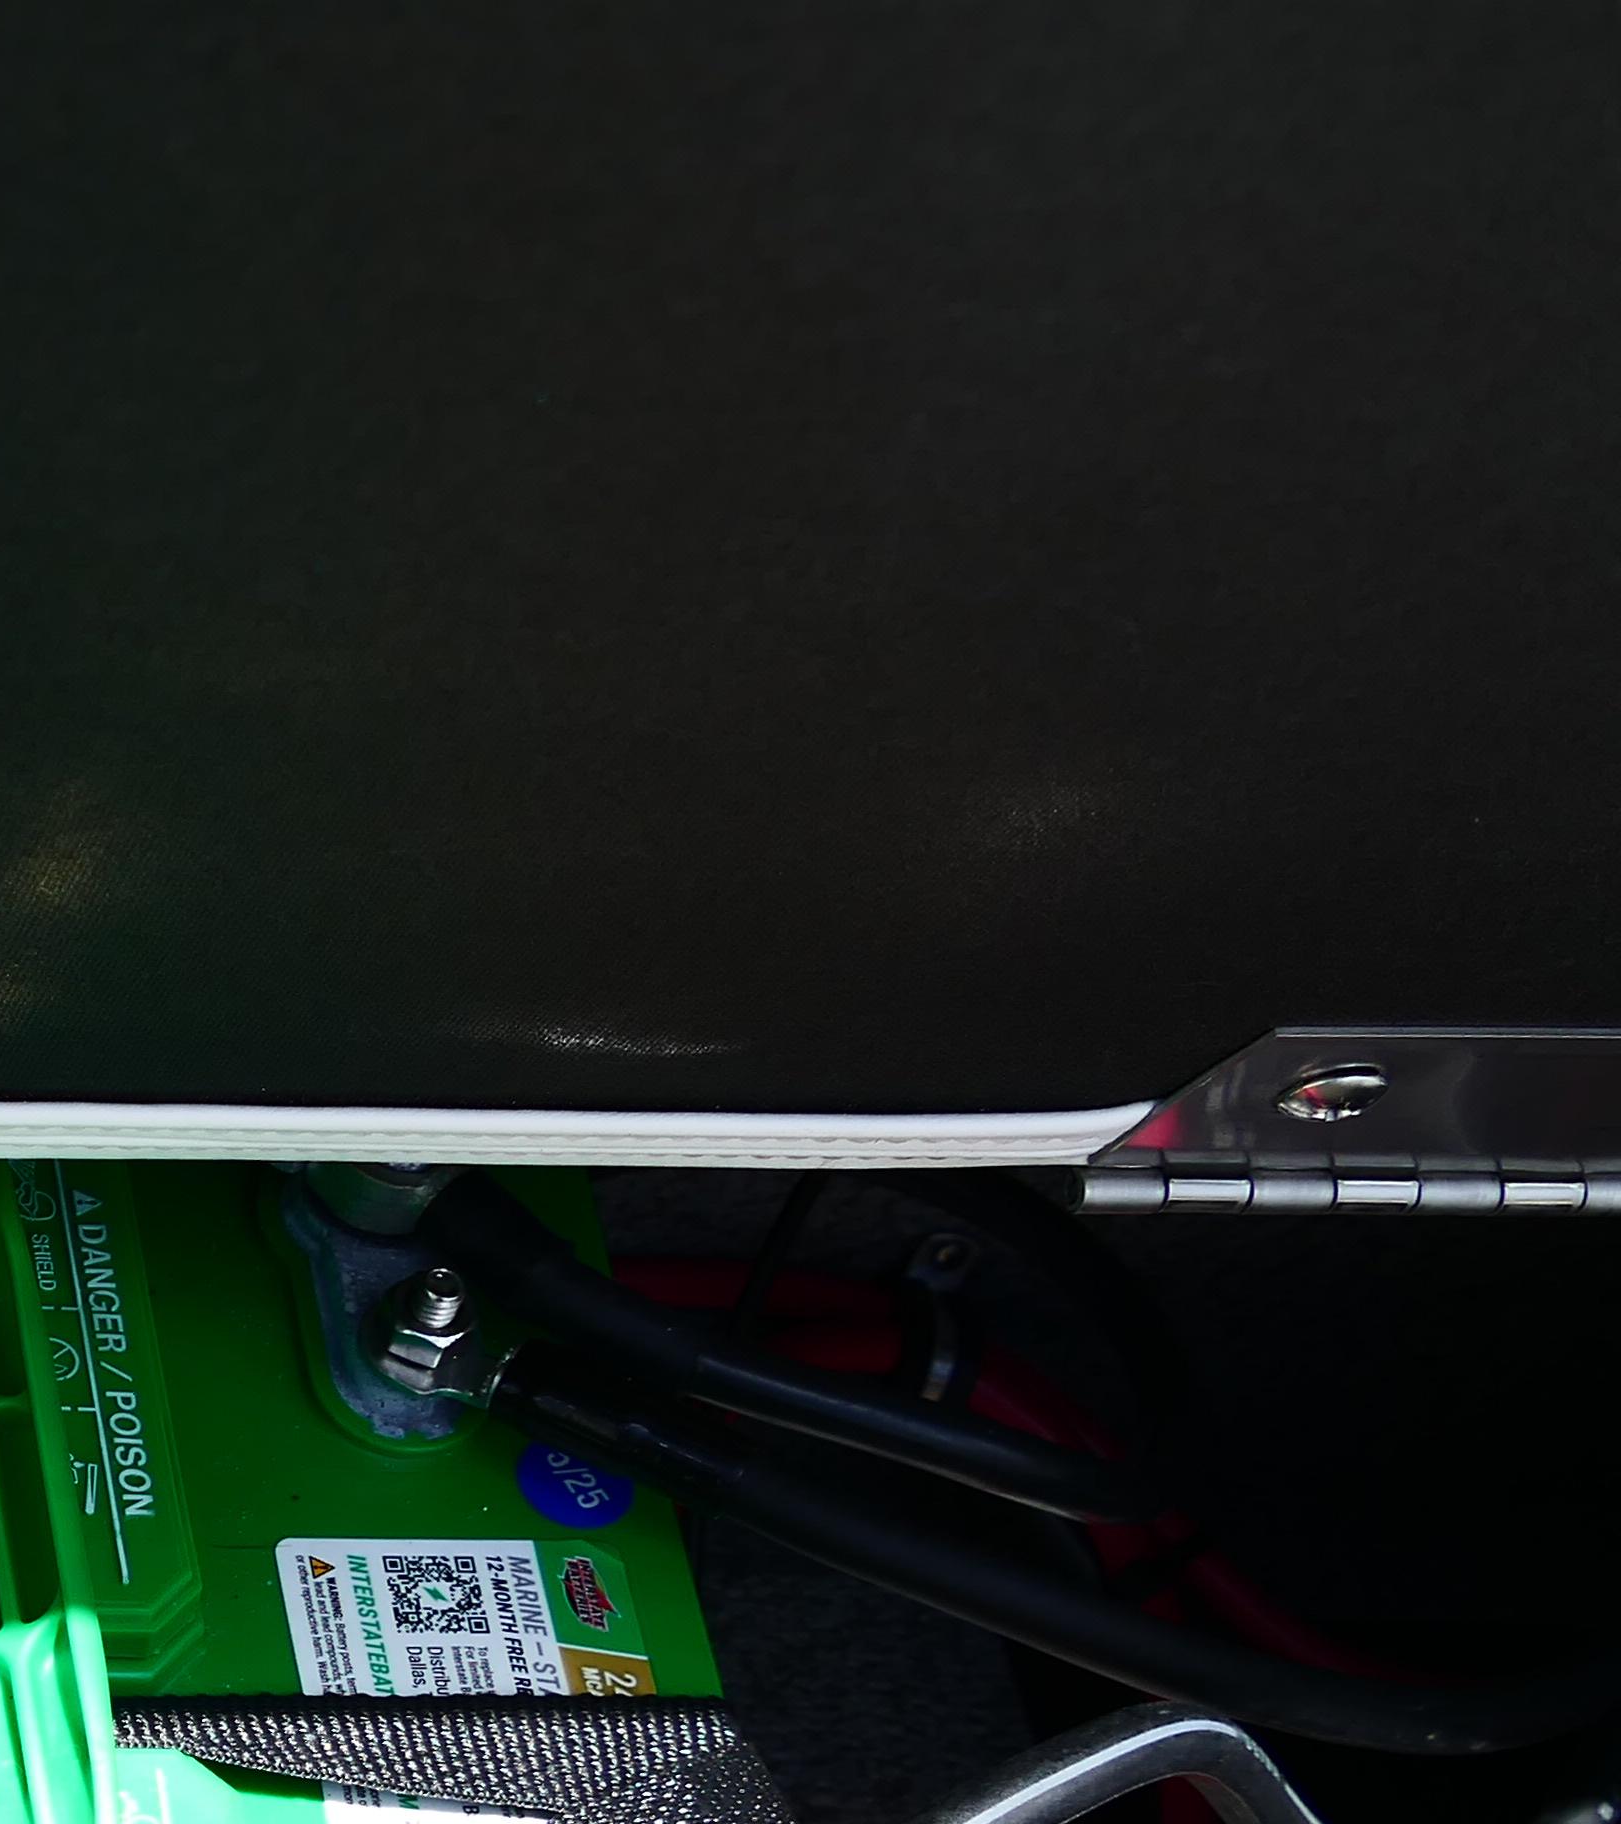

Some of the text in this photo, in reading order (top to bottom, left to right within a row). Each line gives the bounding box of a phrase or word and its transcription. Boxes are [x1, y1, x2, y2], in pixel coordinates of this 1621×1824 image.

[31, 1233, 57, 1291] SHIELD
[77, 1223, 128, 1352] DANGER
[105, 1391, 155, 1517] POISON
[326, 1577, 343, 1621] WARNING:
[485, 1555, 519, 1633] 12-MONTH
[504, 1637, 529, 1674] FREE
[507, 1555, 548, 1636] MARINE
[406, 1646, 427, 1688] Dallas,
[451, 1646, 468, 1688] Interstate
[463, 1646, 482, 1690] For limited
[477, 1646, 494, 1689] To replace
